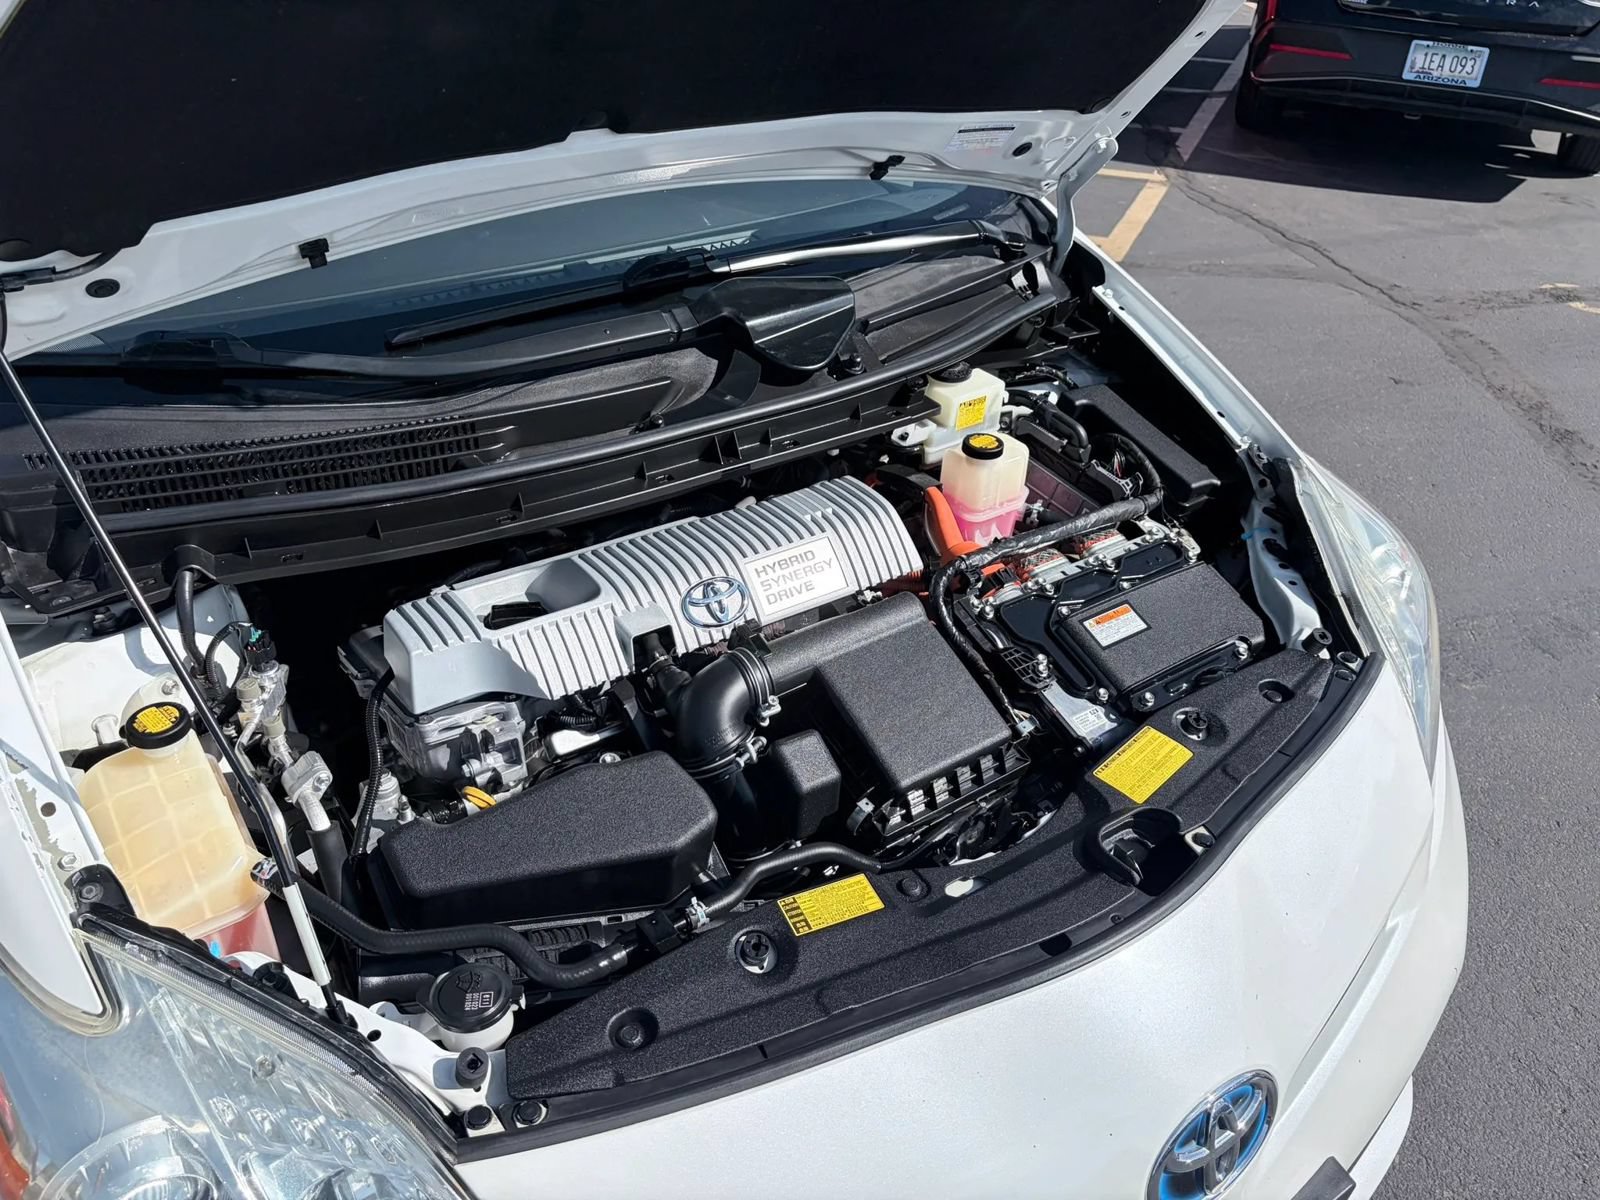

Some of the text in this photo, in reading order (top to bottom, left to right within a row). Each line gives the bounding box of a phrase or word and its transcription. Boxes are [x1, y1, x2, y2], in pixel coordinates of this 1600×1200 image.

[1419, 51, 1477, 75] 1EA 093
[1414, 74, 1467, 85] ARIZONA
[754, 550, 816, 578] HYBRID
[760, 558, 833, 592] SYNERGY
[765, 580, 816, 605] DRIVE
